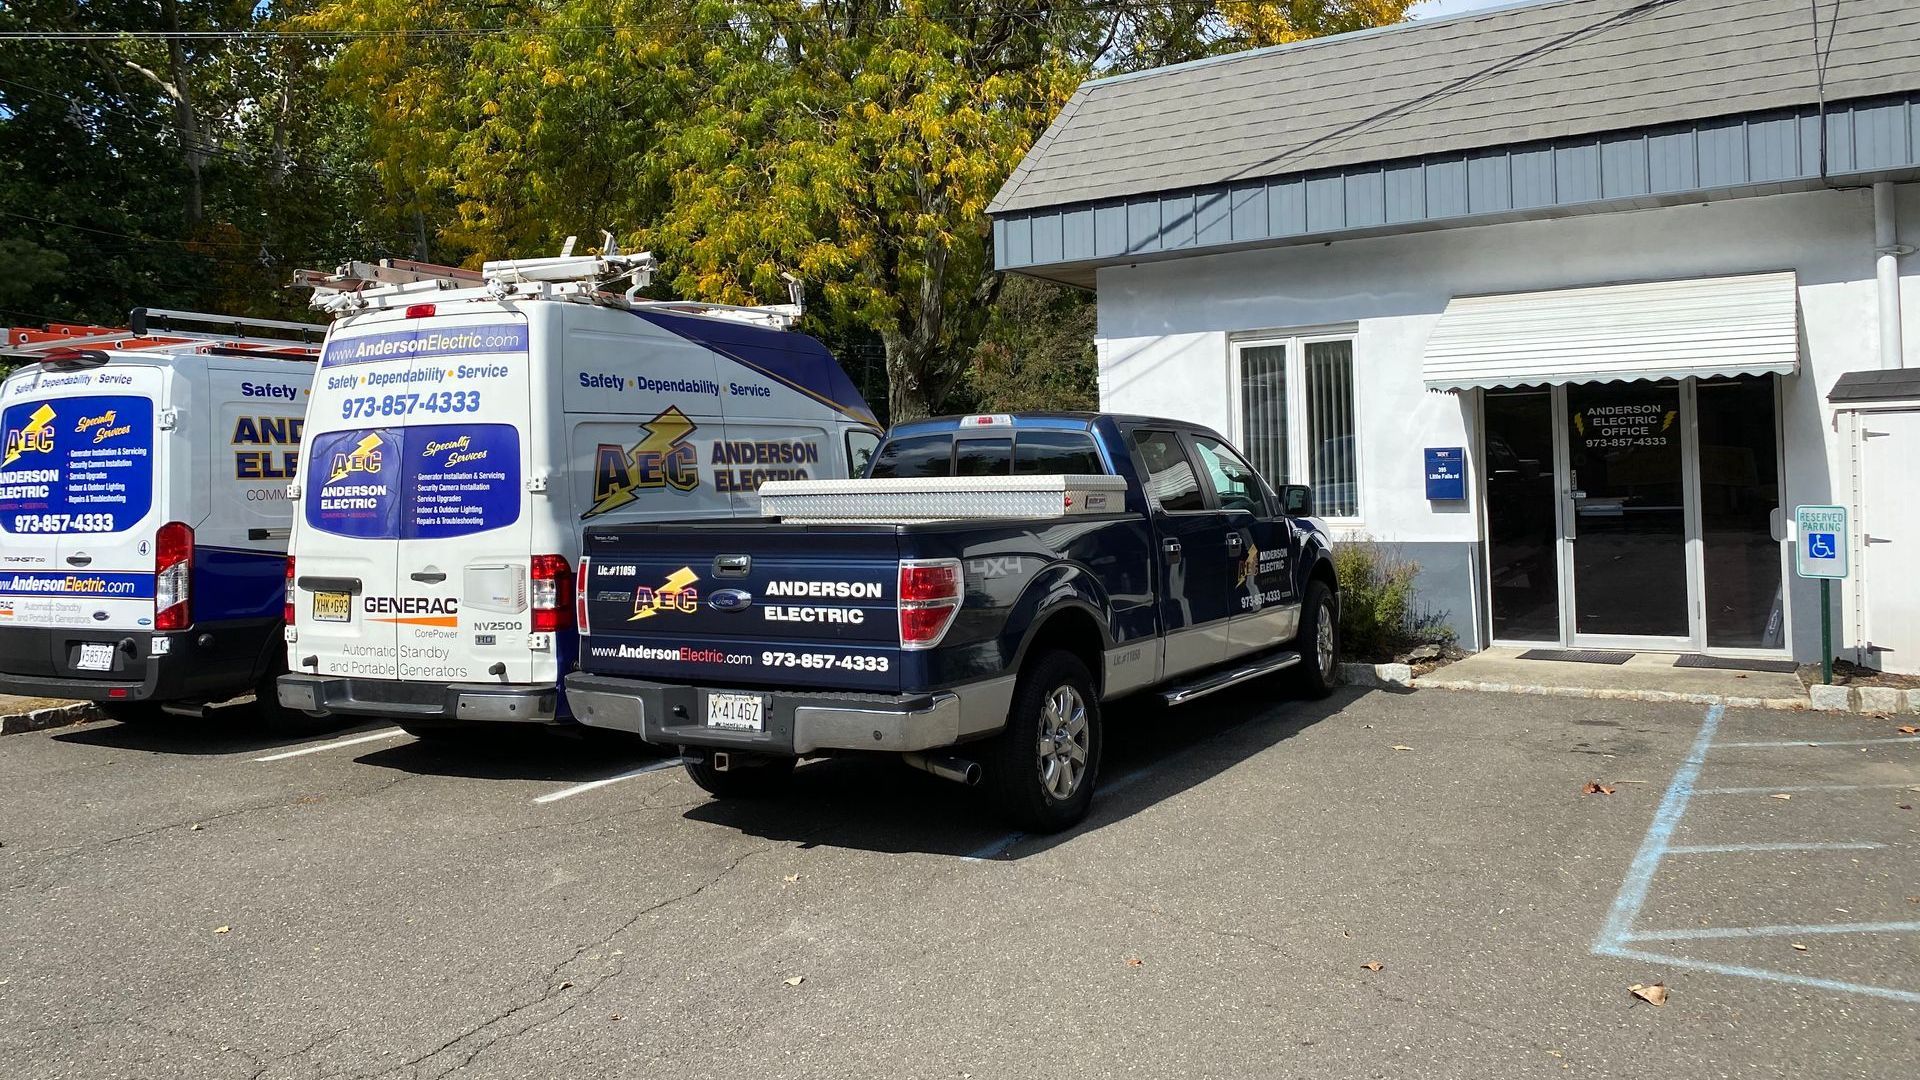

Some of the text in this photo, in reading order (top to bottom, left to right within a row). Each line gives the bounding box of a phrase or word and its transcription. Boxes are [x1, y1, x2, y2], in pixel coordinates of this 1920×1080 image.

[328, 332, 519, 362] www.AndersonElectric.com
[98, 373, 133, 385] Service
[328, 363, 508, 390] Safety Dependability Service
[579, 372, 771, 397] Safety Dependability Service
[241, 382, 297, 400] Safety
[342, 391, 481, 419] 973-857-4333
[1587, 405, 1661, 416] ANDERSON
[1593, 416, 1658, 426] ELECTRIC
[1601, 427, 1649, 436] OFFICE
[422, 435, 471, 456] Specialty
[1585, 437, 1667, 447] 973-857-4333
[445, 450, 488, 467] Services
[711, 440, 819, 465] ANDERSON
[331, 451, 383, 478] AEC
[593, 440, 700, 503] AEC
[478, 471, 505, 480] Servicing
[320, 485, 387, 497] ANDERSON
[320, 498, 377, 510] ELECTRIC
[15, 513, 114, 532] 973-857-4333
[1800, 512, 1844, 522] RESERVED
[1802, 522, 1841, 532] PARKING
[139, 541, 147, 554] 4
[1260, 548, 1288, 561] ANDERSON
[1260, 559, 1285, 574] ELECTRIC
[765, 581, 882, 598] ANDERSON
[364, 597, 458, 614] GENERAC
[634, 586, 698, 614] AEC
[764, 606, 864, 624] ELECTRIC
[414, 628, 458, 639] CorePower
[474, 621, 523, 631] NV2500
[476, 635, 494, 645] HD
[342, 643, 450, 661] Automatic Standby
[591, 644, 889, 672] www.AndersonElectric.com 973-857-4333
[330, 661, 468, 678] and Portable Generators
